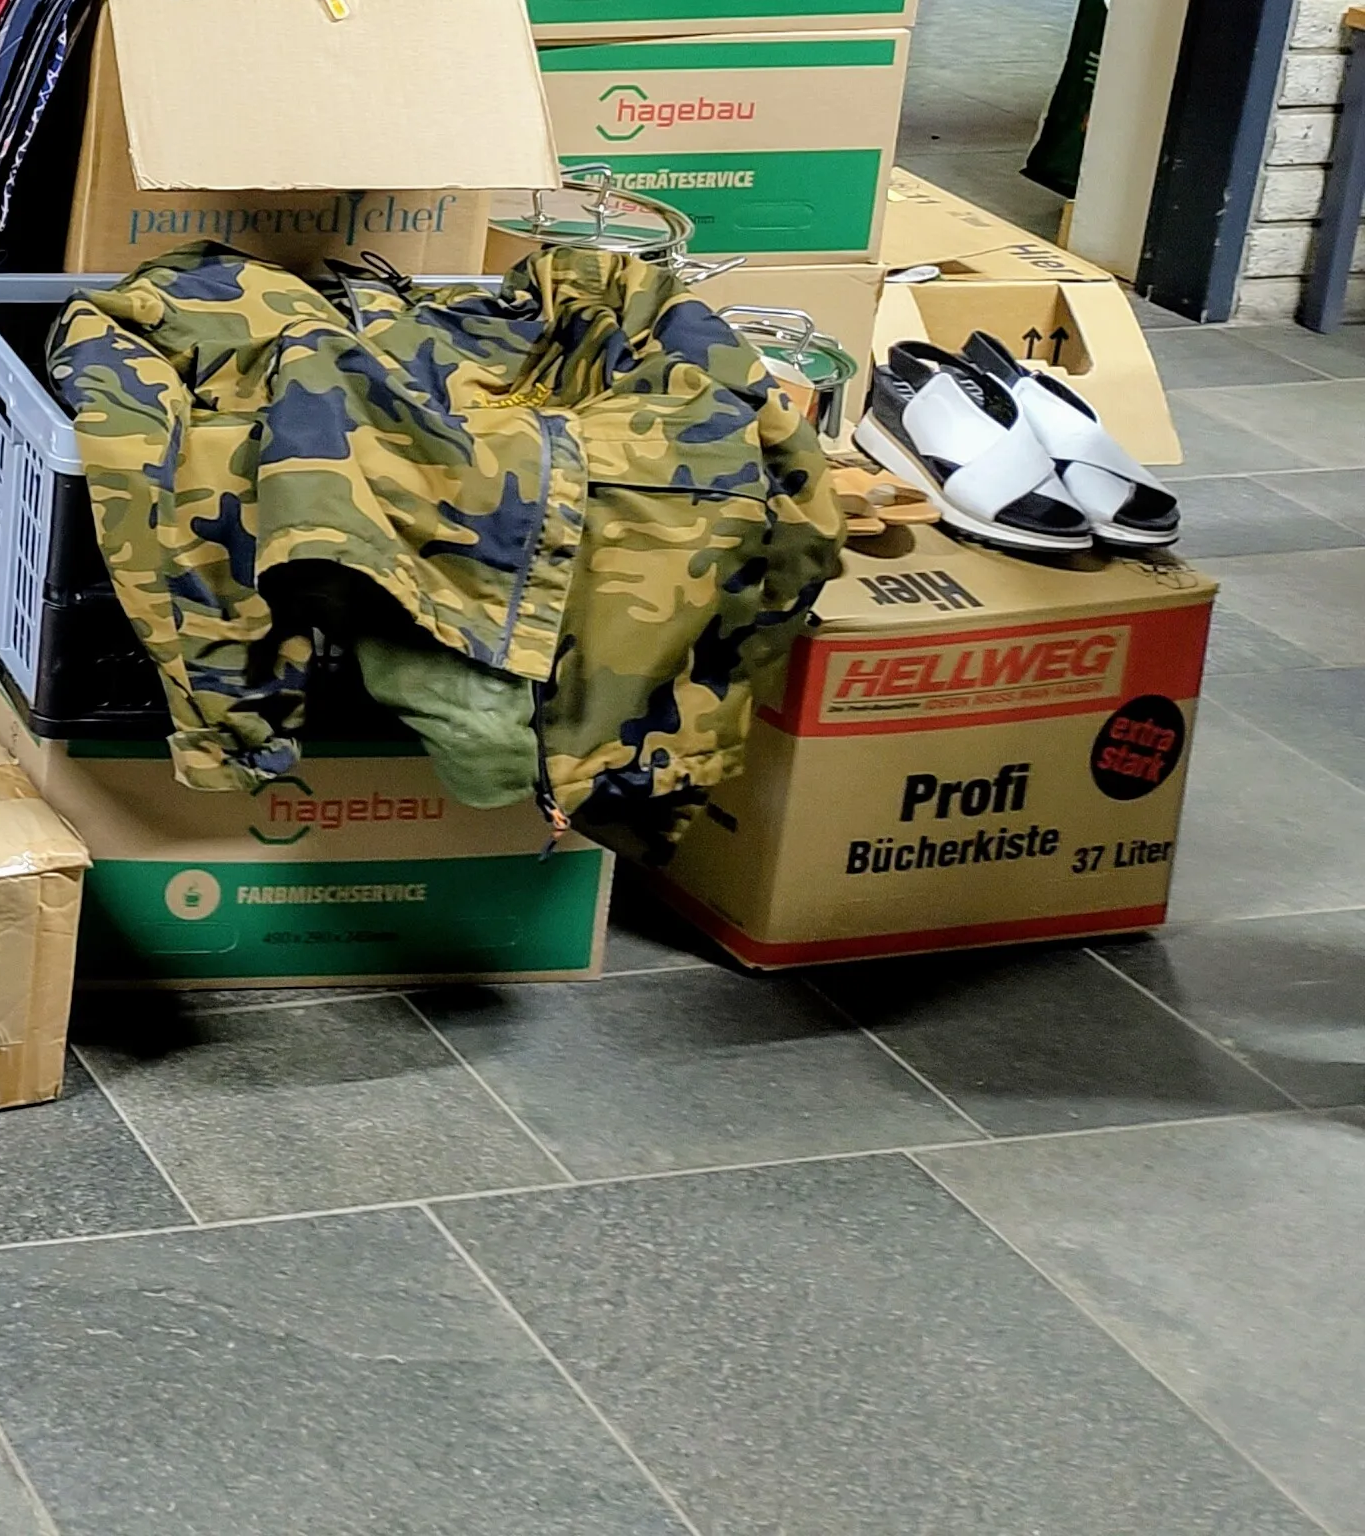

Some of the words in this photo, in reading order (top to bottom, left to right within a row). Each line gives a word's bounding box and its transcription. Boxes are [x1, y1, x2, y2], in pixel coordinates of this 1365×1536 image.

[617, 97, 755, 127] hagebau
[129, 194, 354, 245] pampered
[364, 194, 457, 234] chef
[857, 569, 985, 612] Hier
[834, 634, 1117, 699] HELLWEG
[269, 793, 445, 829] hagebau
[899, 763, 1033, 822] Profi
[846, 826, 1059, 875] Bücherkiste
[1071, 850, 1105, 874] 37
[1113, 839, 1173, 869] Liter
[236, 883, 427, 905] FARBMISCHSERVICE
